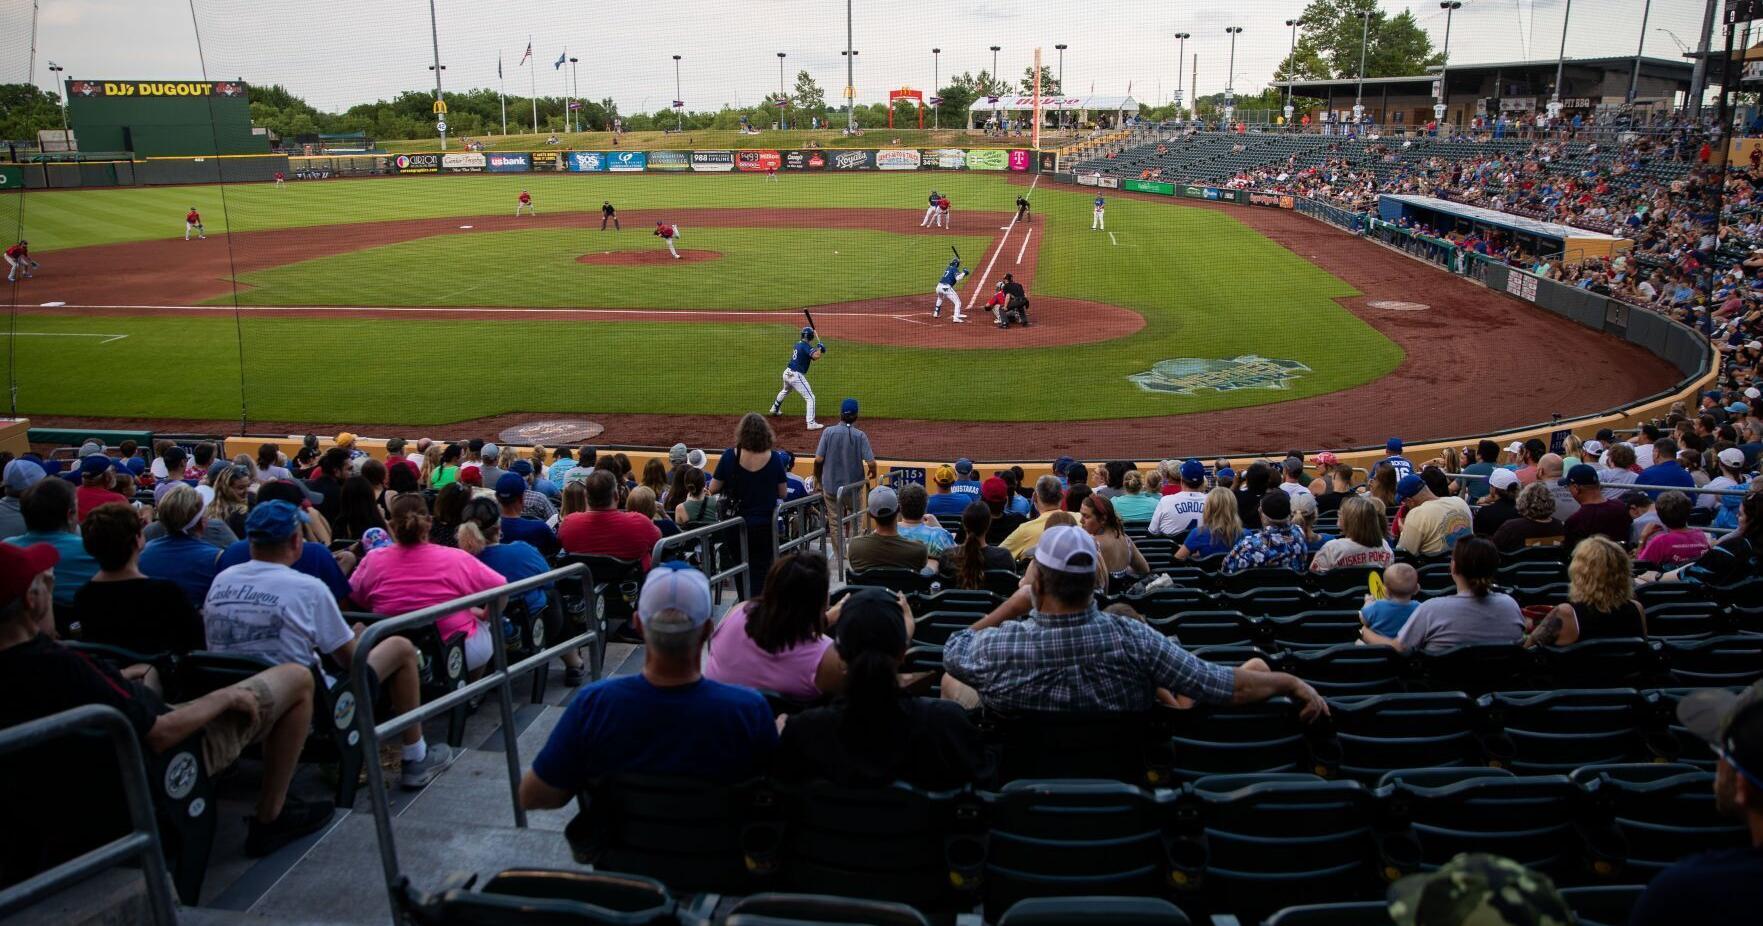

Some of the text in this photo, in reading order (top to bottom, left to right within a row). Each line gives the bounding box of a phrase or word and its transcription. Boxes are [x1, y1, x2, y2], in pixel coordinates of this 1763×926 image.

[105, 83, 134, 98] DJ's
[139, 83, 212, 98] DUGOUT
[1576, 97, 1590, 108] BBQ
[694, 154, 708, 162] 988
[836, 152, 868, 168] Royals
[900, 469, 918, 479] 115
[1175, 501, 1205, 514] GORDO
[1368, 551, 1391, 564] POWER
[236, 584, 280, 605] Flagon
